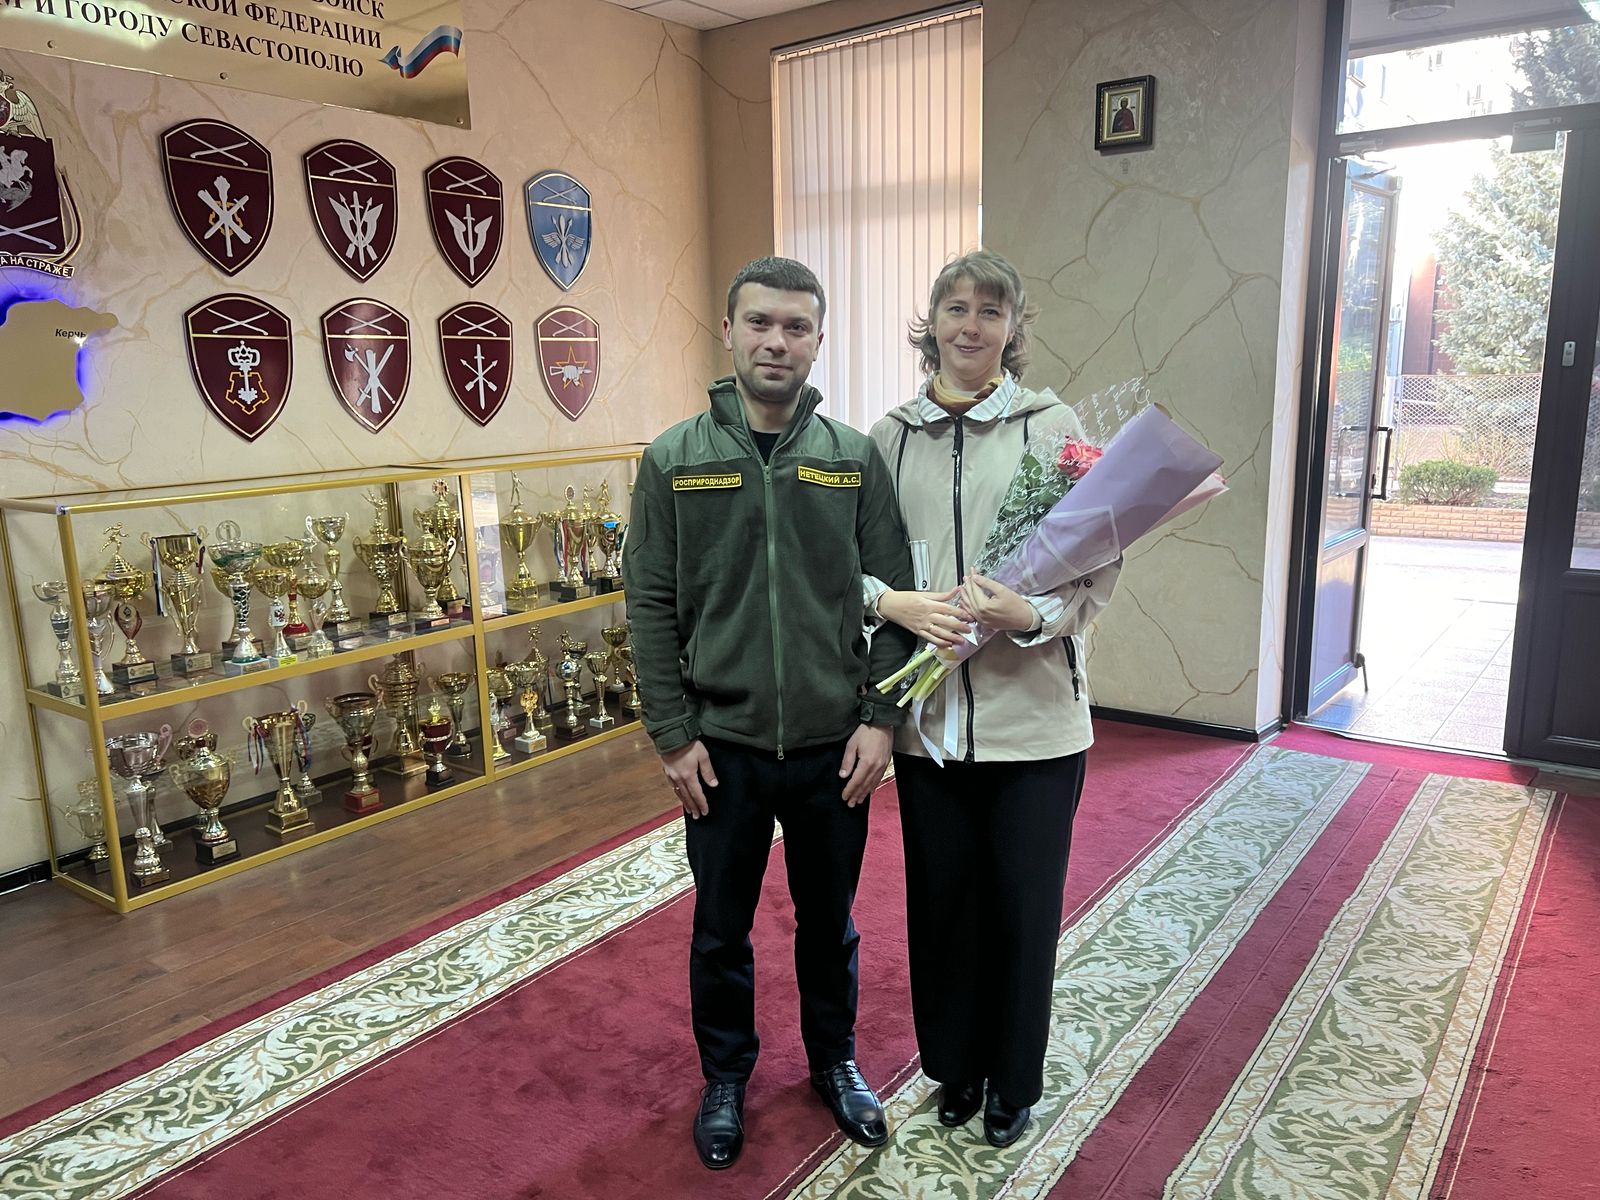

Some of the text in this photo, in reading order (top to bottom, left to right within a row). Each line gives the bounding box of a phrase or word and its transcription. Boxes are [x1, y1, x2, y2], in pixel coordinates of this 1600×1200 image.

[245, 2, 383, 49] ФЕДЕРАЦИИ
[64, 0, 173, 39] ГОРОДУ
[181, 22, 363, 77] СЕВАСТОПОЛЮ
[10, 256, 25, 265] НА
[25, 258, 69, 277] СТРАЖЕ
[55, 328, 87, 339] Керчь
[674, 476, 740, 487] РОСПРИРОДНАДЗОР
